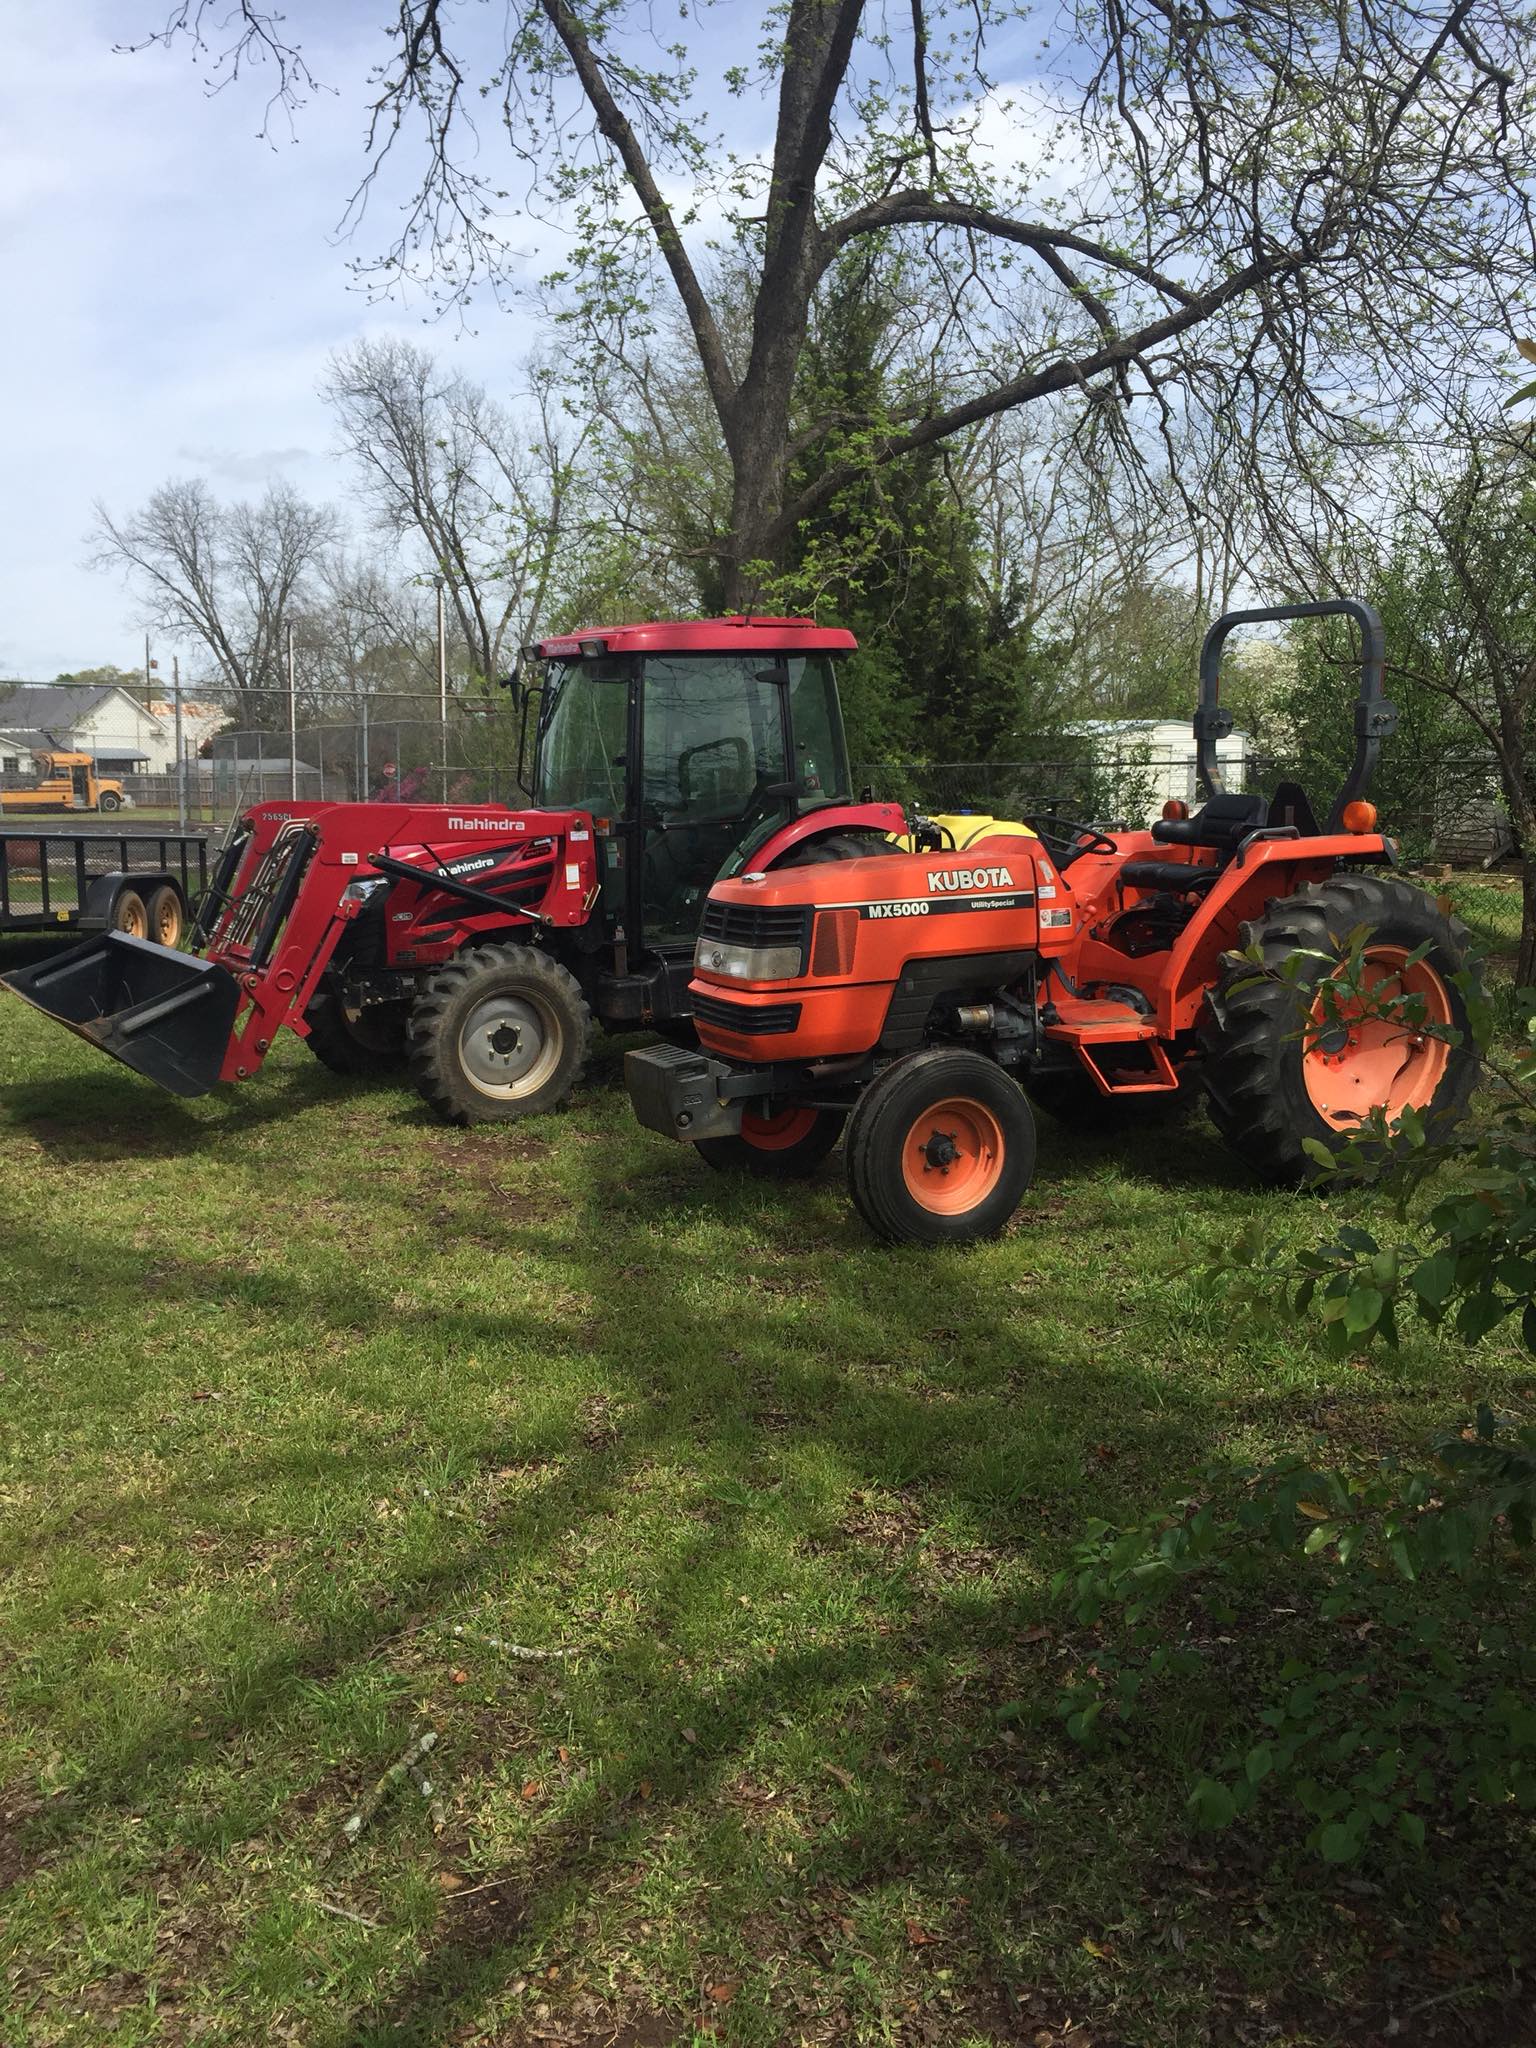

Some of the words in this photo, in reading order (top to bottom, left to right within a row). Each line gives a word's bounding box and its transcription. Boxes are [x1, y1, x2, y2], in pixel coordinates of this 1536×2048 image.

[448, 817, 526, 831] Mahindra
[926, 867, 1015, 893] KUBOTA
[868, 902, 930, 919] MX5000
